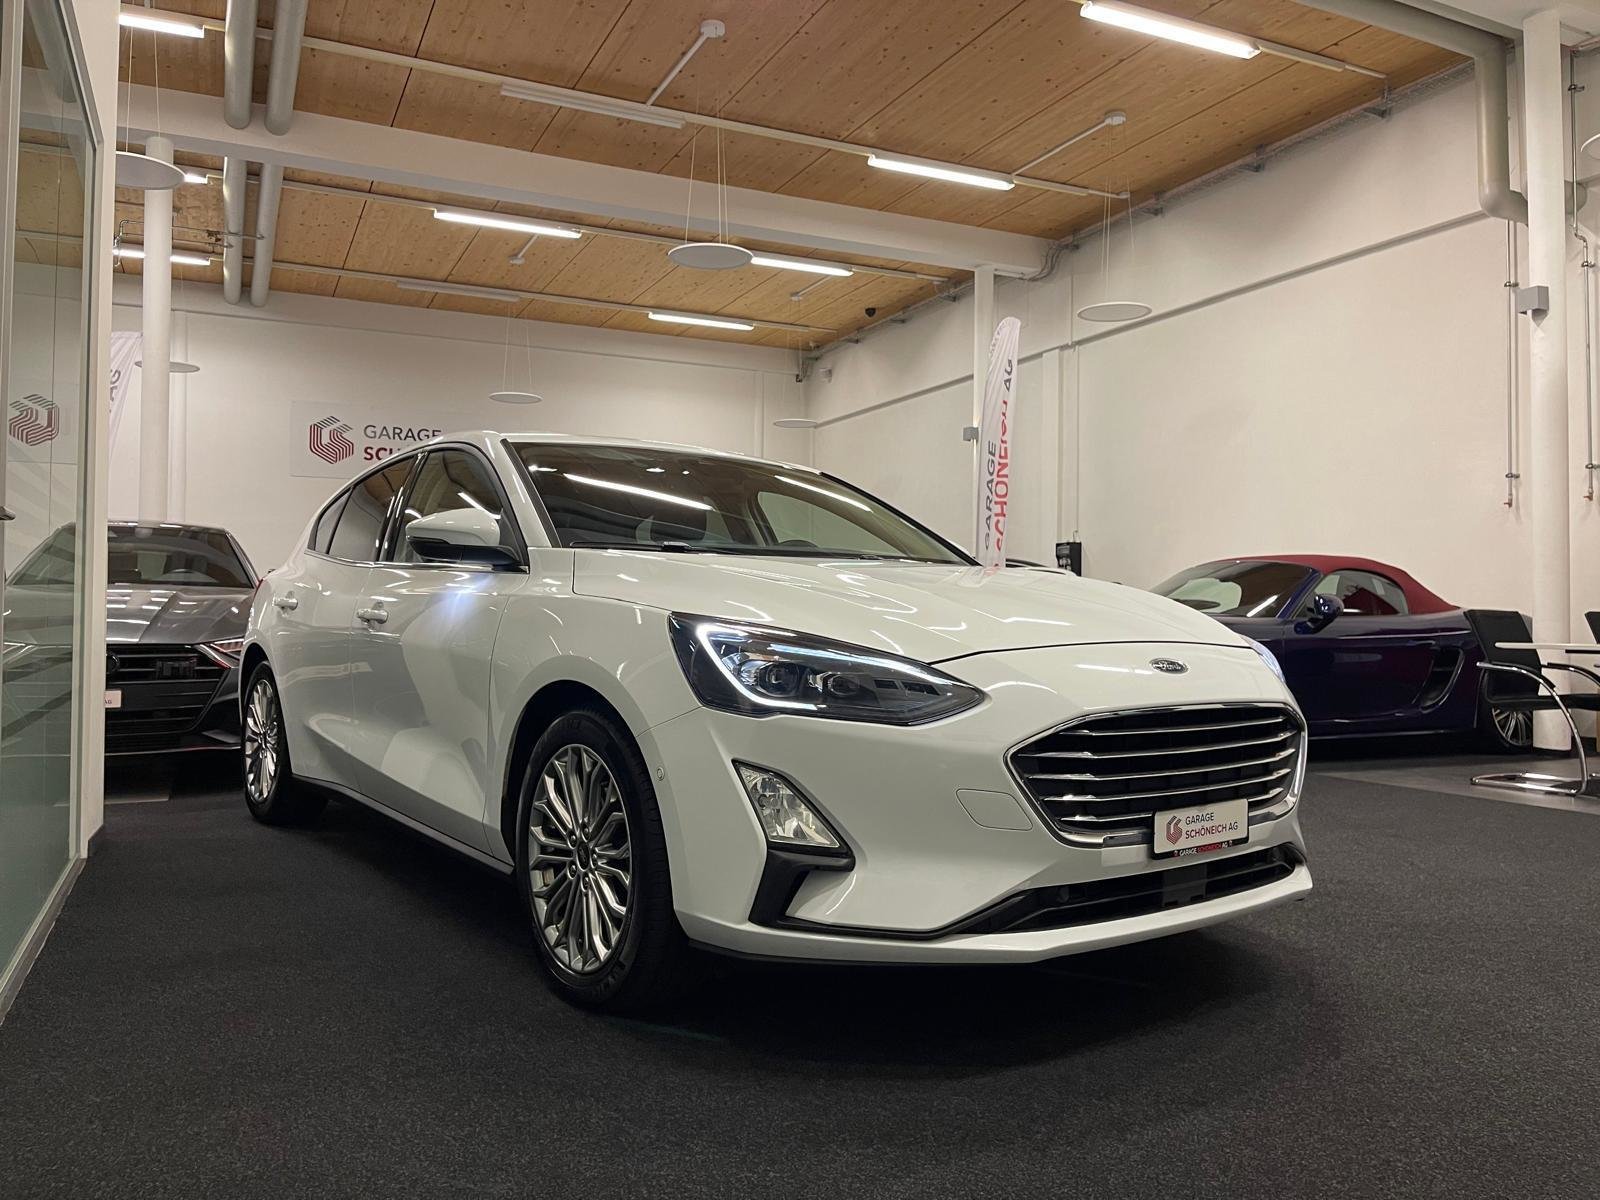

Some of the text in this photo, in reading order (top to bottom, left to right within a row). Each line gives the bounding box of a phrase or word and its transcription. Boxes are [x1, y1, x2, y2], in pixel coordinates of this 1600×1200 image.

[1003, 359, 1013, 392] AG
[363, 424, 442, 441] GARAGE
[985, 440, 997, 551] GARAGE
[1185, 812, 1215, 825] GARAGE
[1185, 821, 1238, 839] SCHÖNEICH AG
